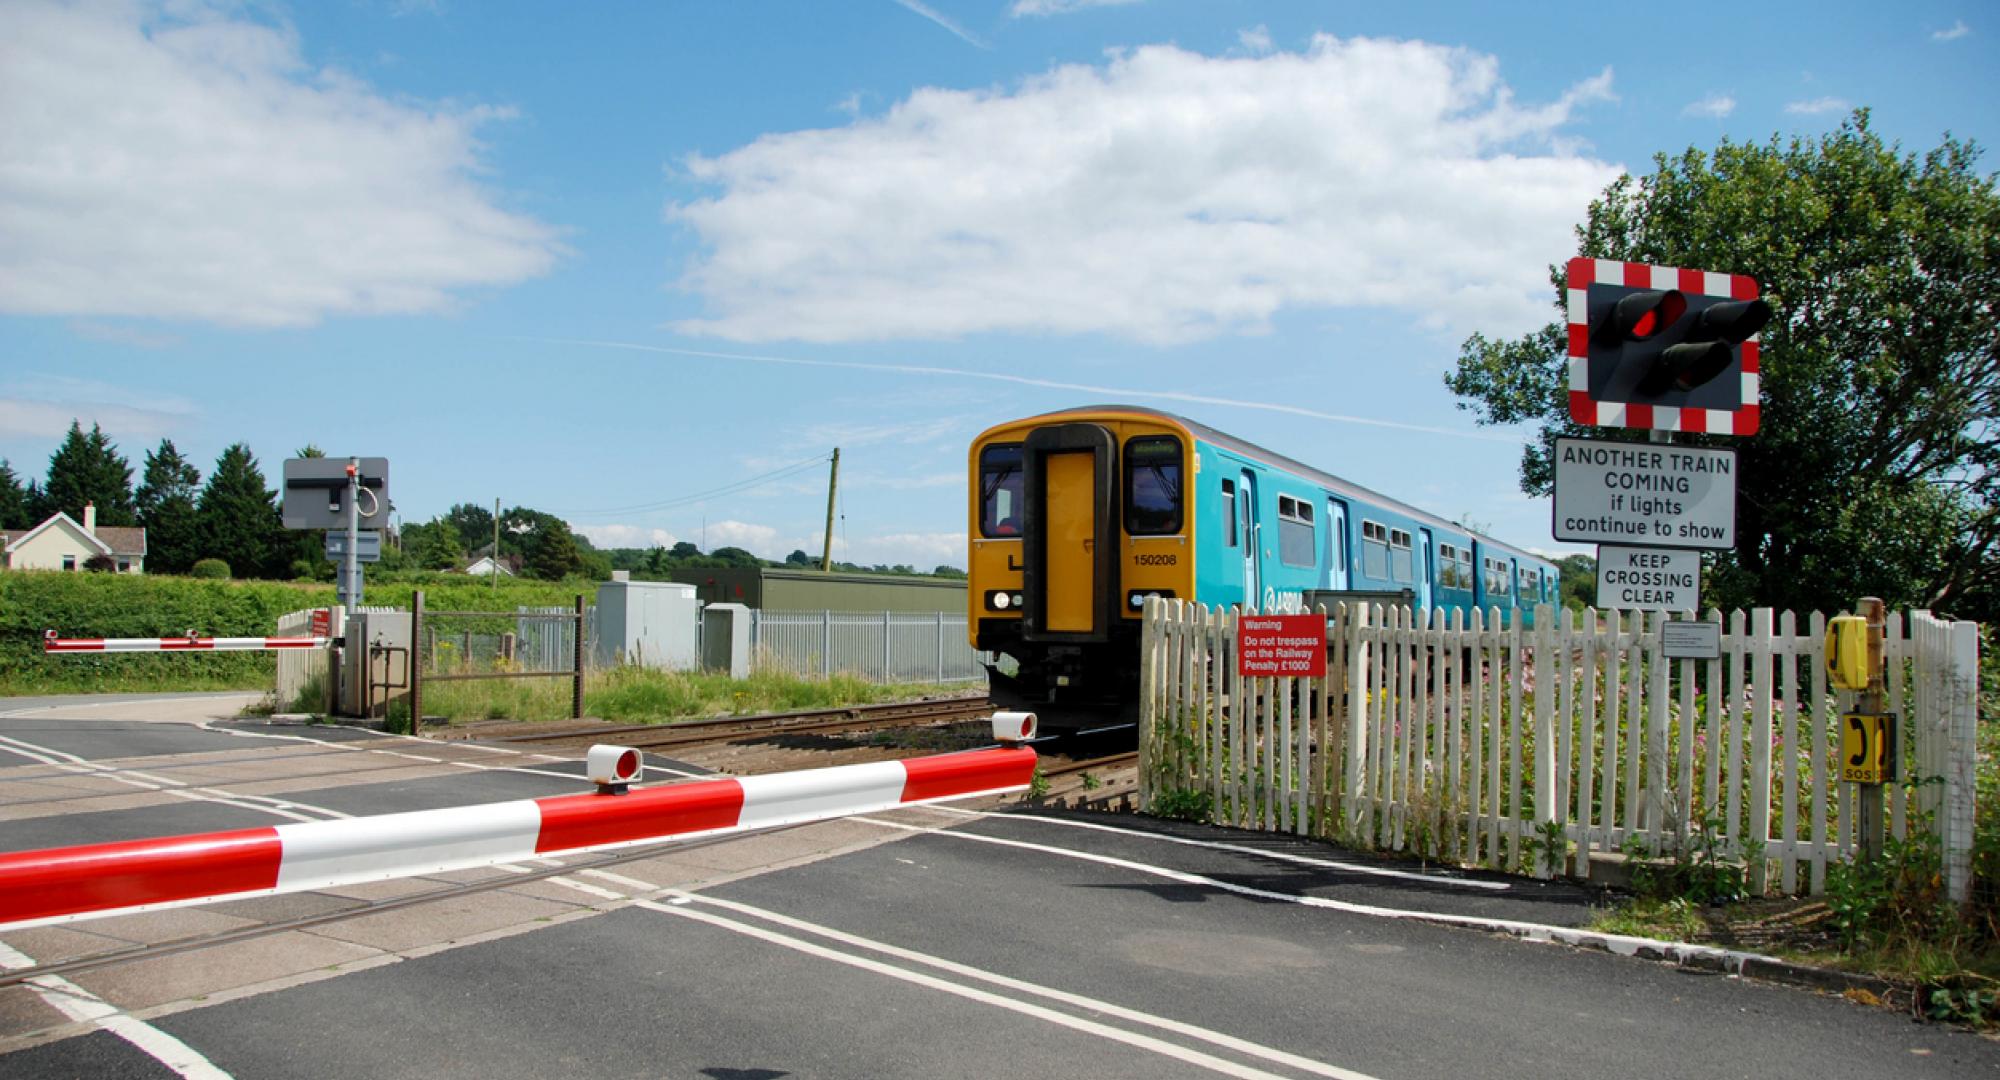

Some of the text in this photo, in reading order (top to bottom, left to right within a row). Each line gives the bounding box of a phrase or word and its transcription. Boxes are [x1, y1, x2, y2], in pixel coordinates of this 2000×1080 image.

[1563, 447, 1730, 474] ANOTHER TRAIN
[1604, 472, 1690, 493] COMING
[1611, 494, 1682, 516] if lights
[1565, 516, 1725, 540] continue to show
[1133, 554, 1177, 566] 150208
[1628, 553, 1671, 569] KEEP
[1604, 570, 1693, 588] CROSSING
[1622, 588, 1675, 604] CLEAR
[1244, 620, 1282, 631] Warning
[1244, 636, 1319, 648] Do not trespass
[1244, 648, 1313, 660] on the Railway
[1245, 660, 1311, 672] Penalty £1000
[1845, 768, 1872, 780] SOS
